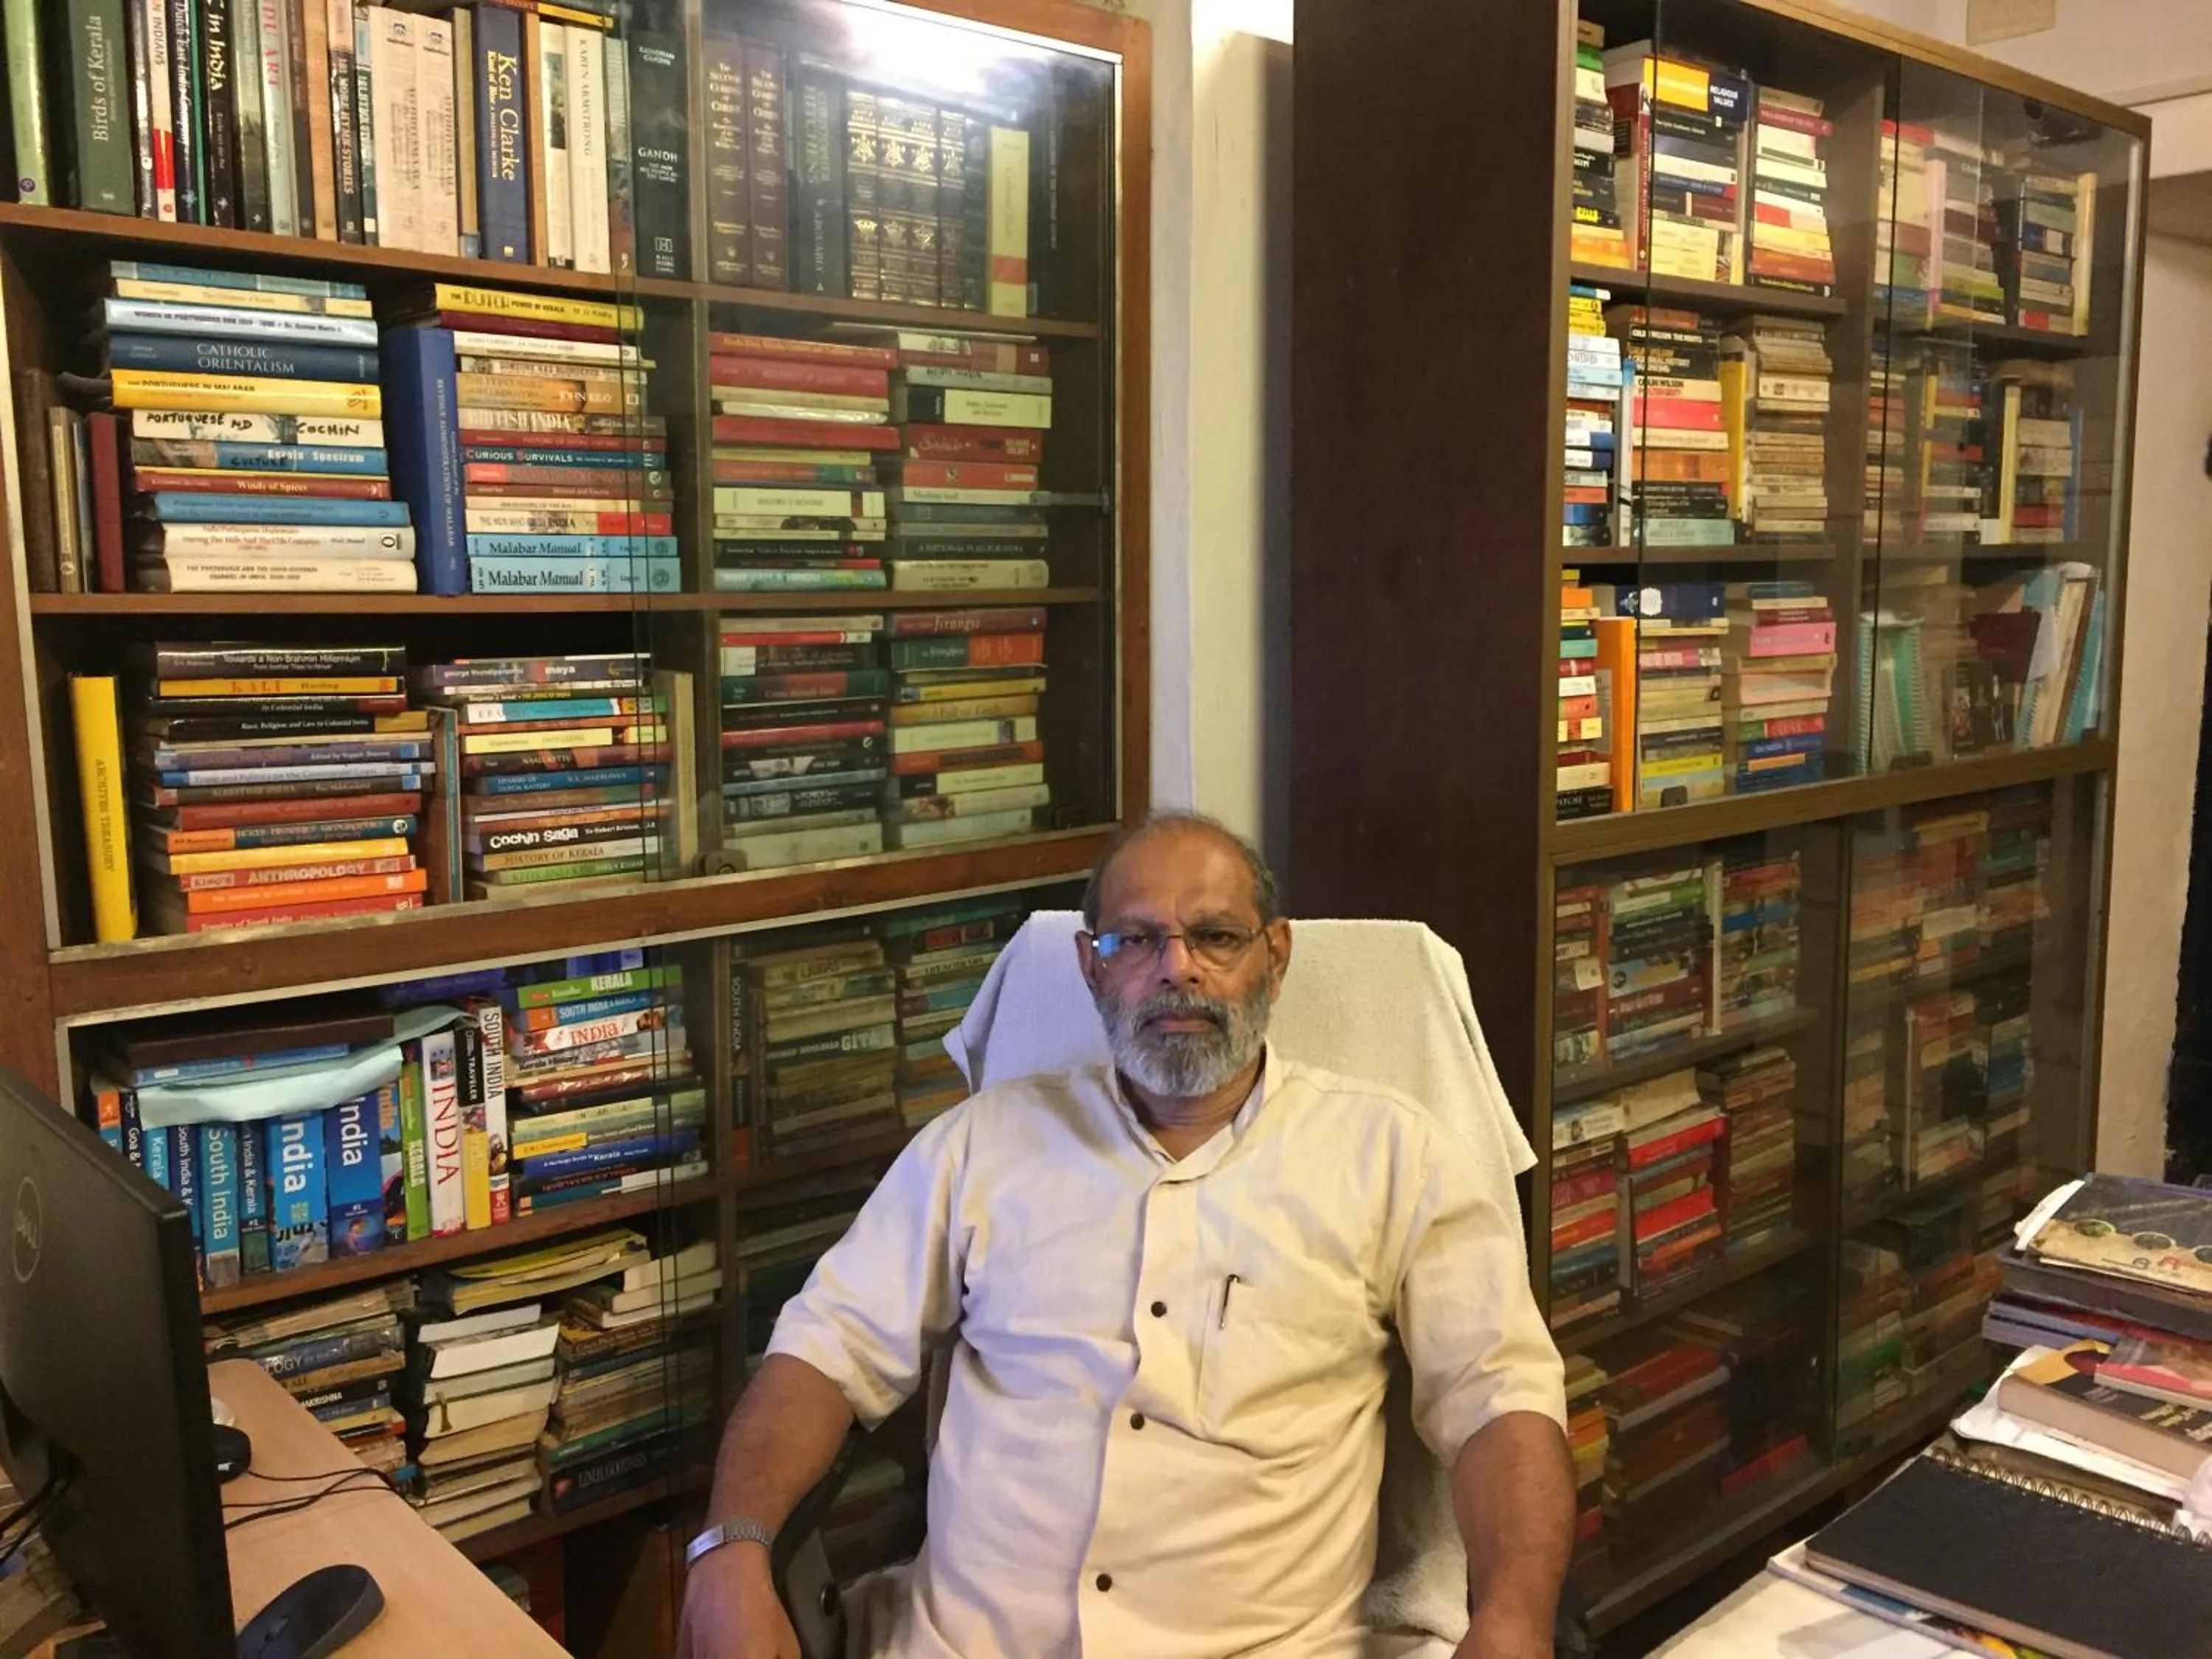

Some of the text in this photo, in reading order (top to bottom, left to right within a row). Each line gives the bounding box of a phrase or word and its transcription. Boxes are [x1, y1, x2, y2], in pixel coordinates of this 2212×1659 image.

[207, 13, 225, 34] in
[153, 16, 165, 66] INDIANS
[209, 39, 227, 91] India
[264, 46, 280, 91] ART
[86, 15, 109, 142] Birds of Kerala
[338, 76, 349, 109] MORE
[579, 39, 592, 157] KAREN ARMSTRONG
[497, 52, 520, 181] Ken Clarke
[342, 147, 354, 195] STORIES
[196, 342, 273, 359] CATHOLIC
[198, 356, 295, 374] ORIENTALISM
[1638, 378, 1658, 387] CLIN
[558, 390, 586, 403] JOHN
[147, 412, 225, 426] PORTUGUESE
[312, 451, 366, 464] Spectrum
[465, 448, 514, 462] CURIOUS
[516, 450, 573, 463] SURVIVALS
[236, 480, 308, 493] Winds of Spices
[548, 518, 576, 529] INDIA
[489, 541, 582, 554] Malabar Manual
[487, 569, 585, 587] Malabar Manual
[223, 655, 256, 664] Towards
[266, 655, 319, 664] Non-Brahmin
[320, 653, 361, 663] Millennium
[544, 665, 577, 675] maya
[260, 720, 288, 730] Religion
[310, 751, 331, 760] Edited
[218, 773, 235, 782] and
[94, 759, 115, 872] ARCHIVES TREASURY
[489, 827, 579, 849] Cochin Saga
[504, 847, 605, 866] HISTORY OF KERALA
[248, 862, 366, 885] ANTHROPOLOGY
[591, 971, 633, 992] KERALA
[558, 1002, 586, 1020] SOUTH
[483, 1012, 504, 1099] SOUTH INDIA
[518, 1057, 546, 1071] Kerala
[468, 1054, 479, 1101] TRAVELER
[128, 1127, 139, 1150] Goa
[178, 1125, 190, 1156] South
[431, 1082, 461, 1186] INDIA
[151, 1136, 164, 1180] Kerala
[243, 1138, 255, 1167] India
[282, 1121, 314, 1194] ndia
[408, 1138, 425, 1188] KERALA
[593, 1150, 621, 1163] Kerala
[179, 1158, 190, 1183] India
[207, 1126, 232, 1239] South India
[244, 1179, 257, 1214] Kerala
